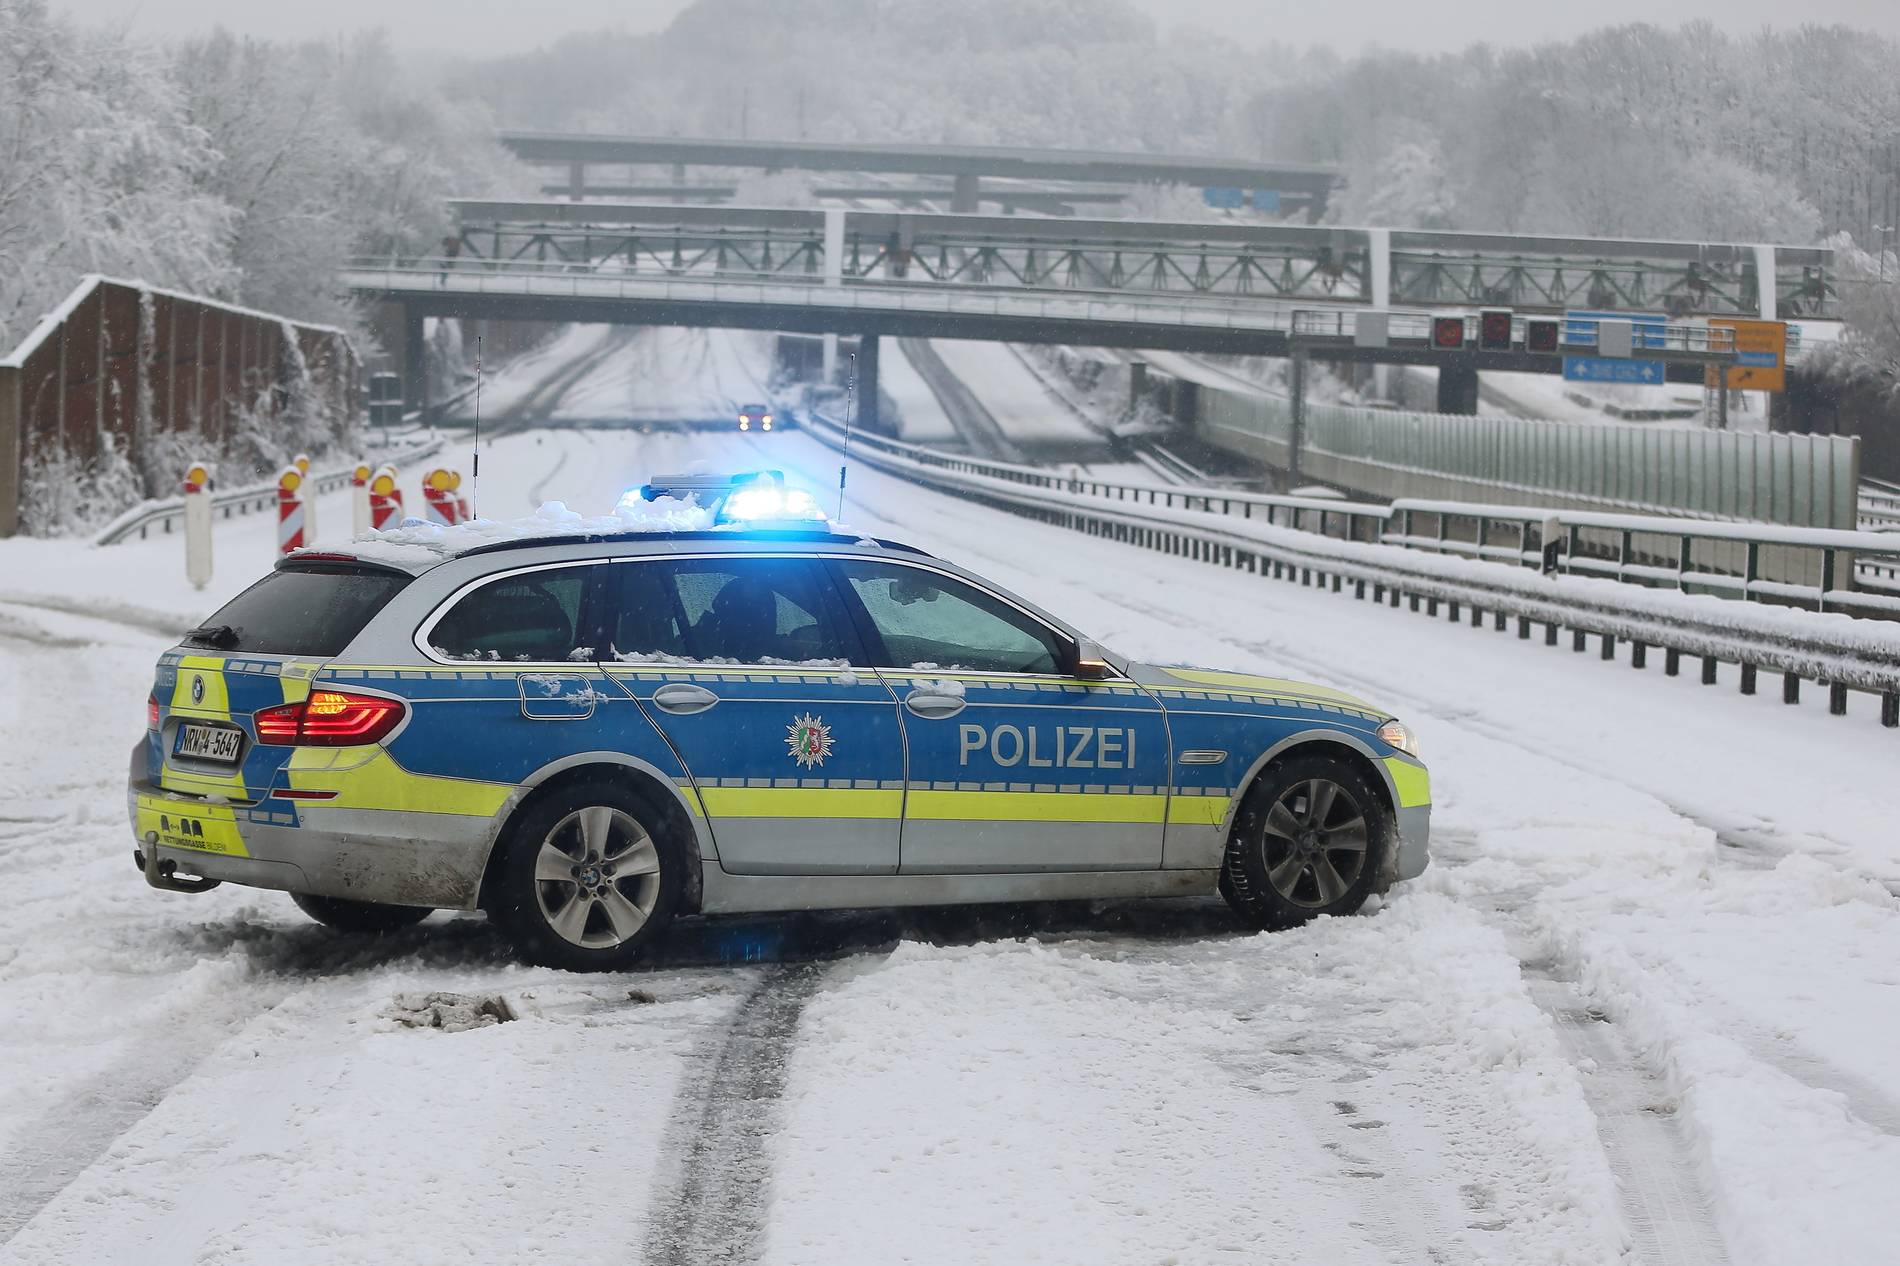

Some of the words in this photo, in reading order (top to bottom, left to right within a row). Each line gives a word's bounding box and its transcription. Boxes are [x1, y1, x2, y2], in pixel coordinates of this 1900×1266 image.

[184, 728, 202, 752] NRW
[203, 731, 241, 757] 4-5647
[959, 724, 1136, 769] POLIZEI
[164, 836, 206, 850] RETTUNGSGASSE
